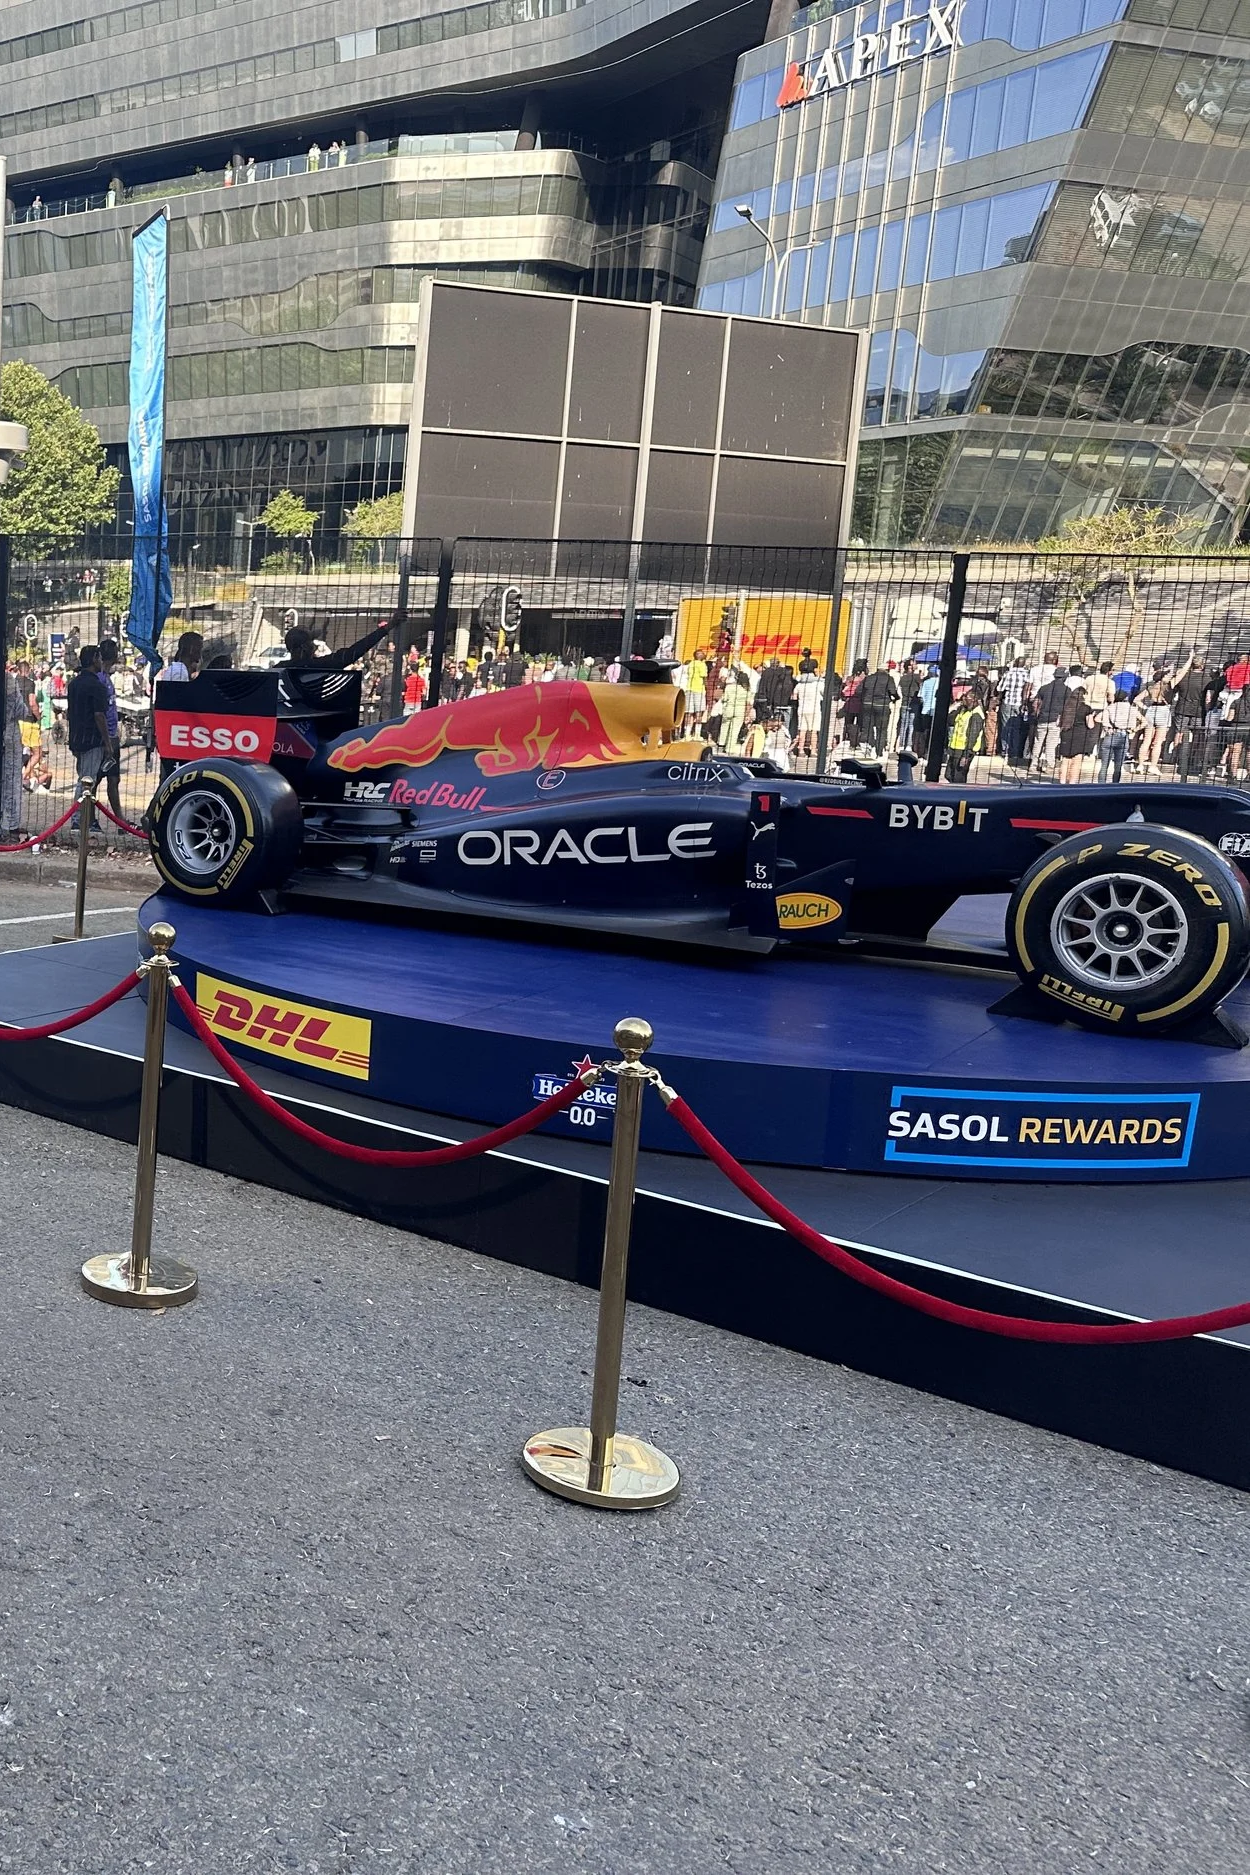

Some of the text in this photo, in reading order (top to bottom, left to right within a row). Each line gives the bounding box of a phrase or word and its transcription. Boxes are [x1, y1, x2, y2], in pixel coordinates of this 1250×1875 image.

[806, 1, 964, 97] APEX
[170, 724, 260, 753] ESSO
[667, 762, 726, 783] citrix
[152, 770, 198, 823] ZERO
[343, 781, 391, 799] HRC
[388, 778, 487, 811] Red Bull
[757, 794, 770, 813] 1
[889, 800, 989, 832] BYBIT
[457, 821, 717, 866] ORACLE
[216, 838, 255, 890] PIRELLI
[1076, 843, 1223, 907] P ZERO
[745, 880, 773, 890] Tezos
[778, 903, 830, 918] RAUCH
[1038, 973, 1126, 1022] PIRELLI
[212, 989, 340, 1061] DHL
[569, 1105, 596, 1127] 0.0
[887, 1110, 1182, 1145] SASOL REWARDS
